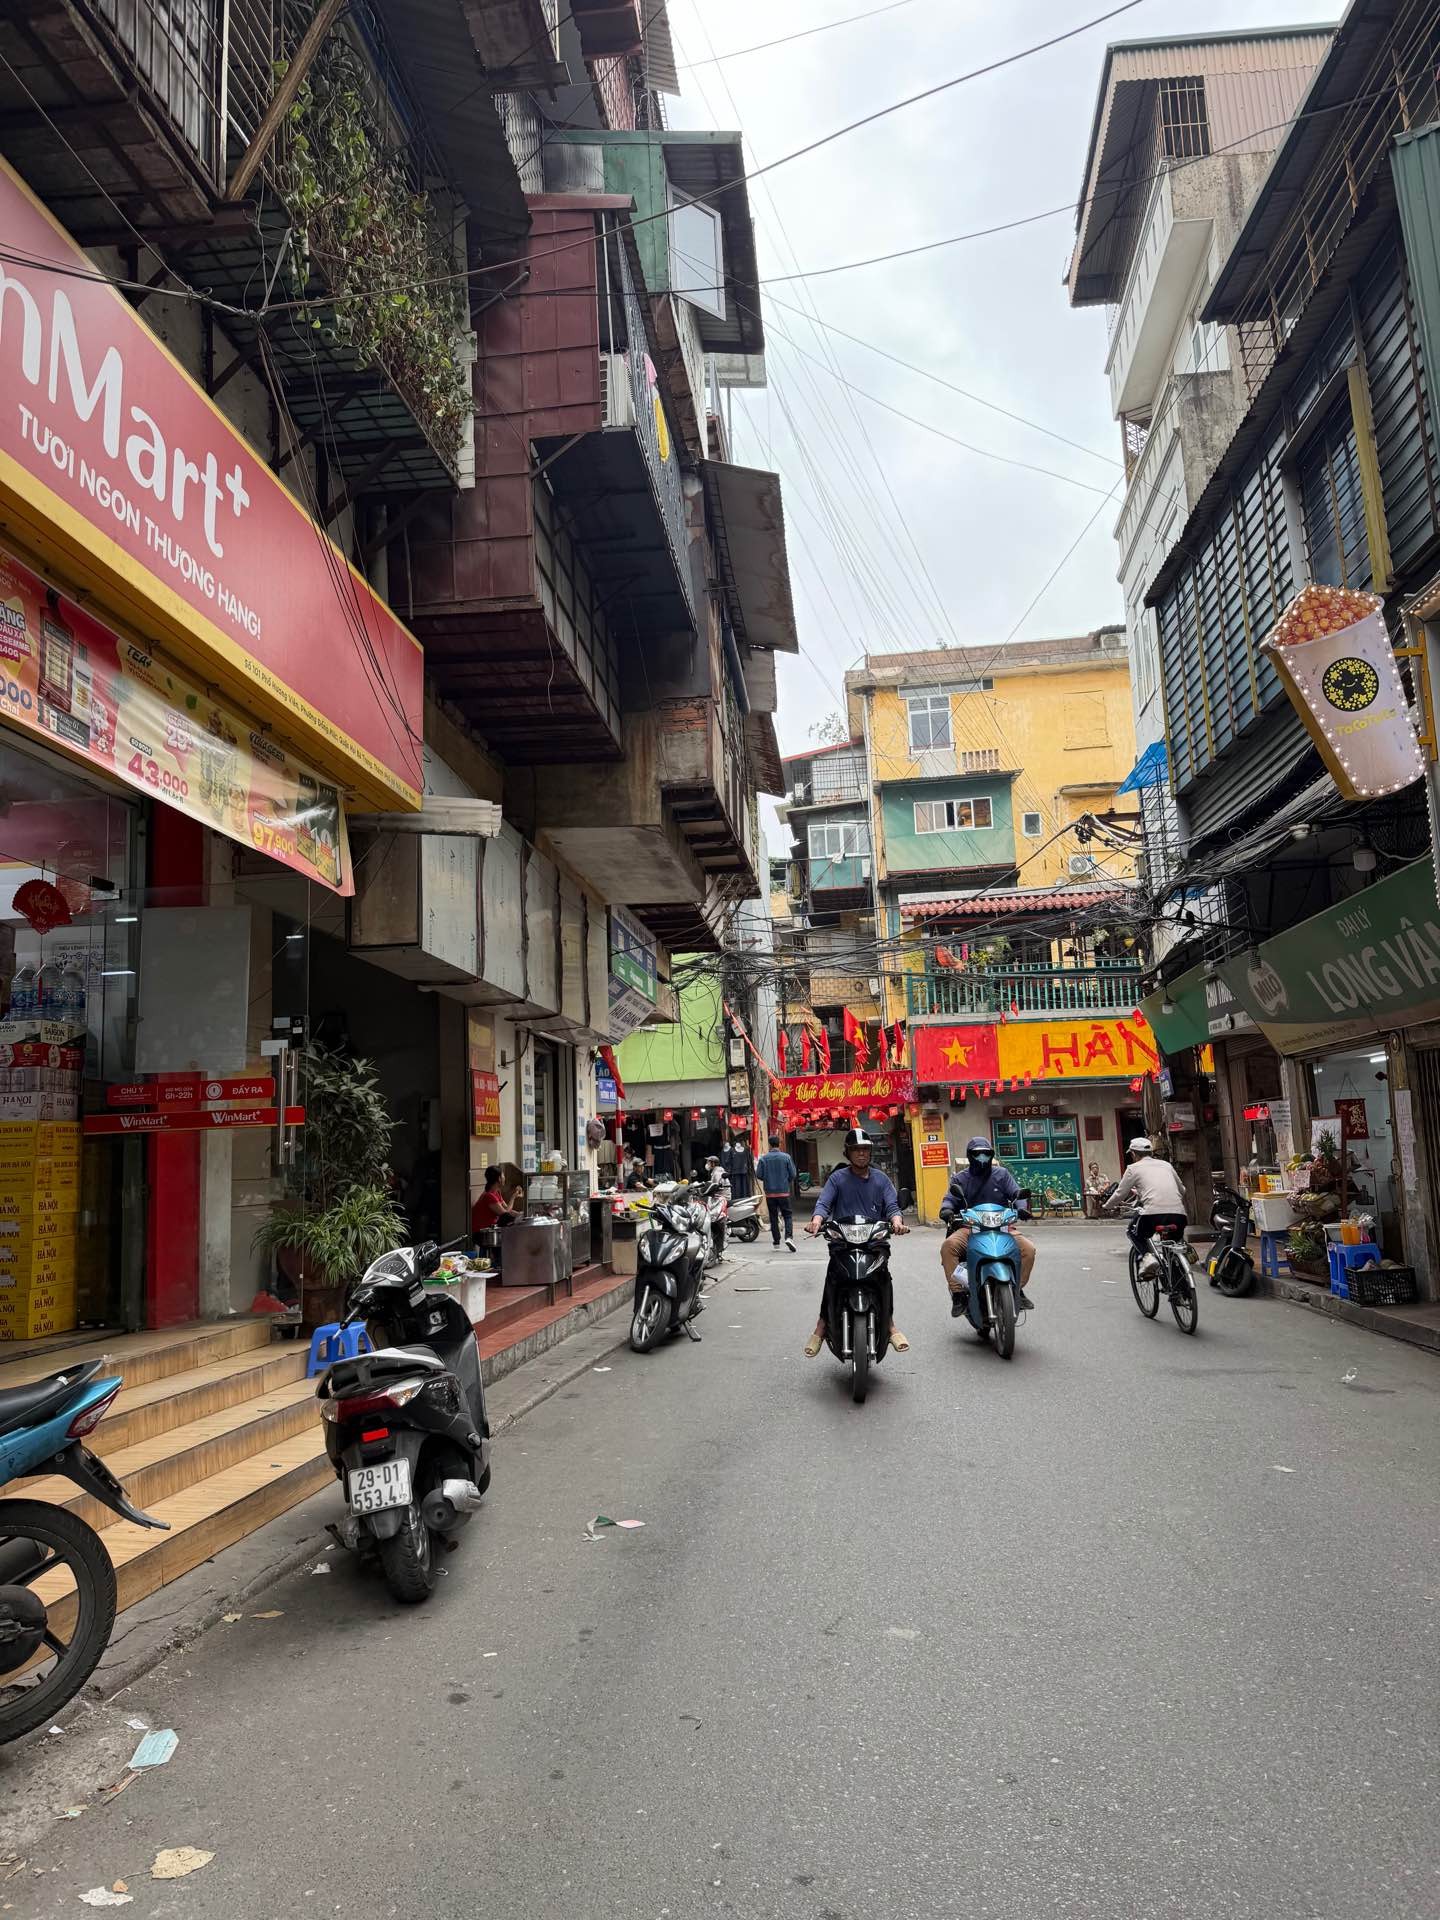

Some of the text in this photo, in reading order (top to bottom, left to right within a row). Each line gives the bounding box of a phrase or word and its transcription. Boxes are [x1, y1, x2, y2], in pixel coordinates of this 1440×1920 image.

[18, 403, 262, 640] TƯƠI NGON THƯỢNG HẠNG!
[128, 752, 190, 797] 43.000
[1306, 945, 1404, 1014] LONG
[251, 1086, 263, 1095] RA
[357, 1463, 399, 1490] 29-D1
